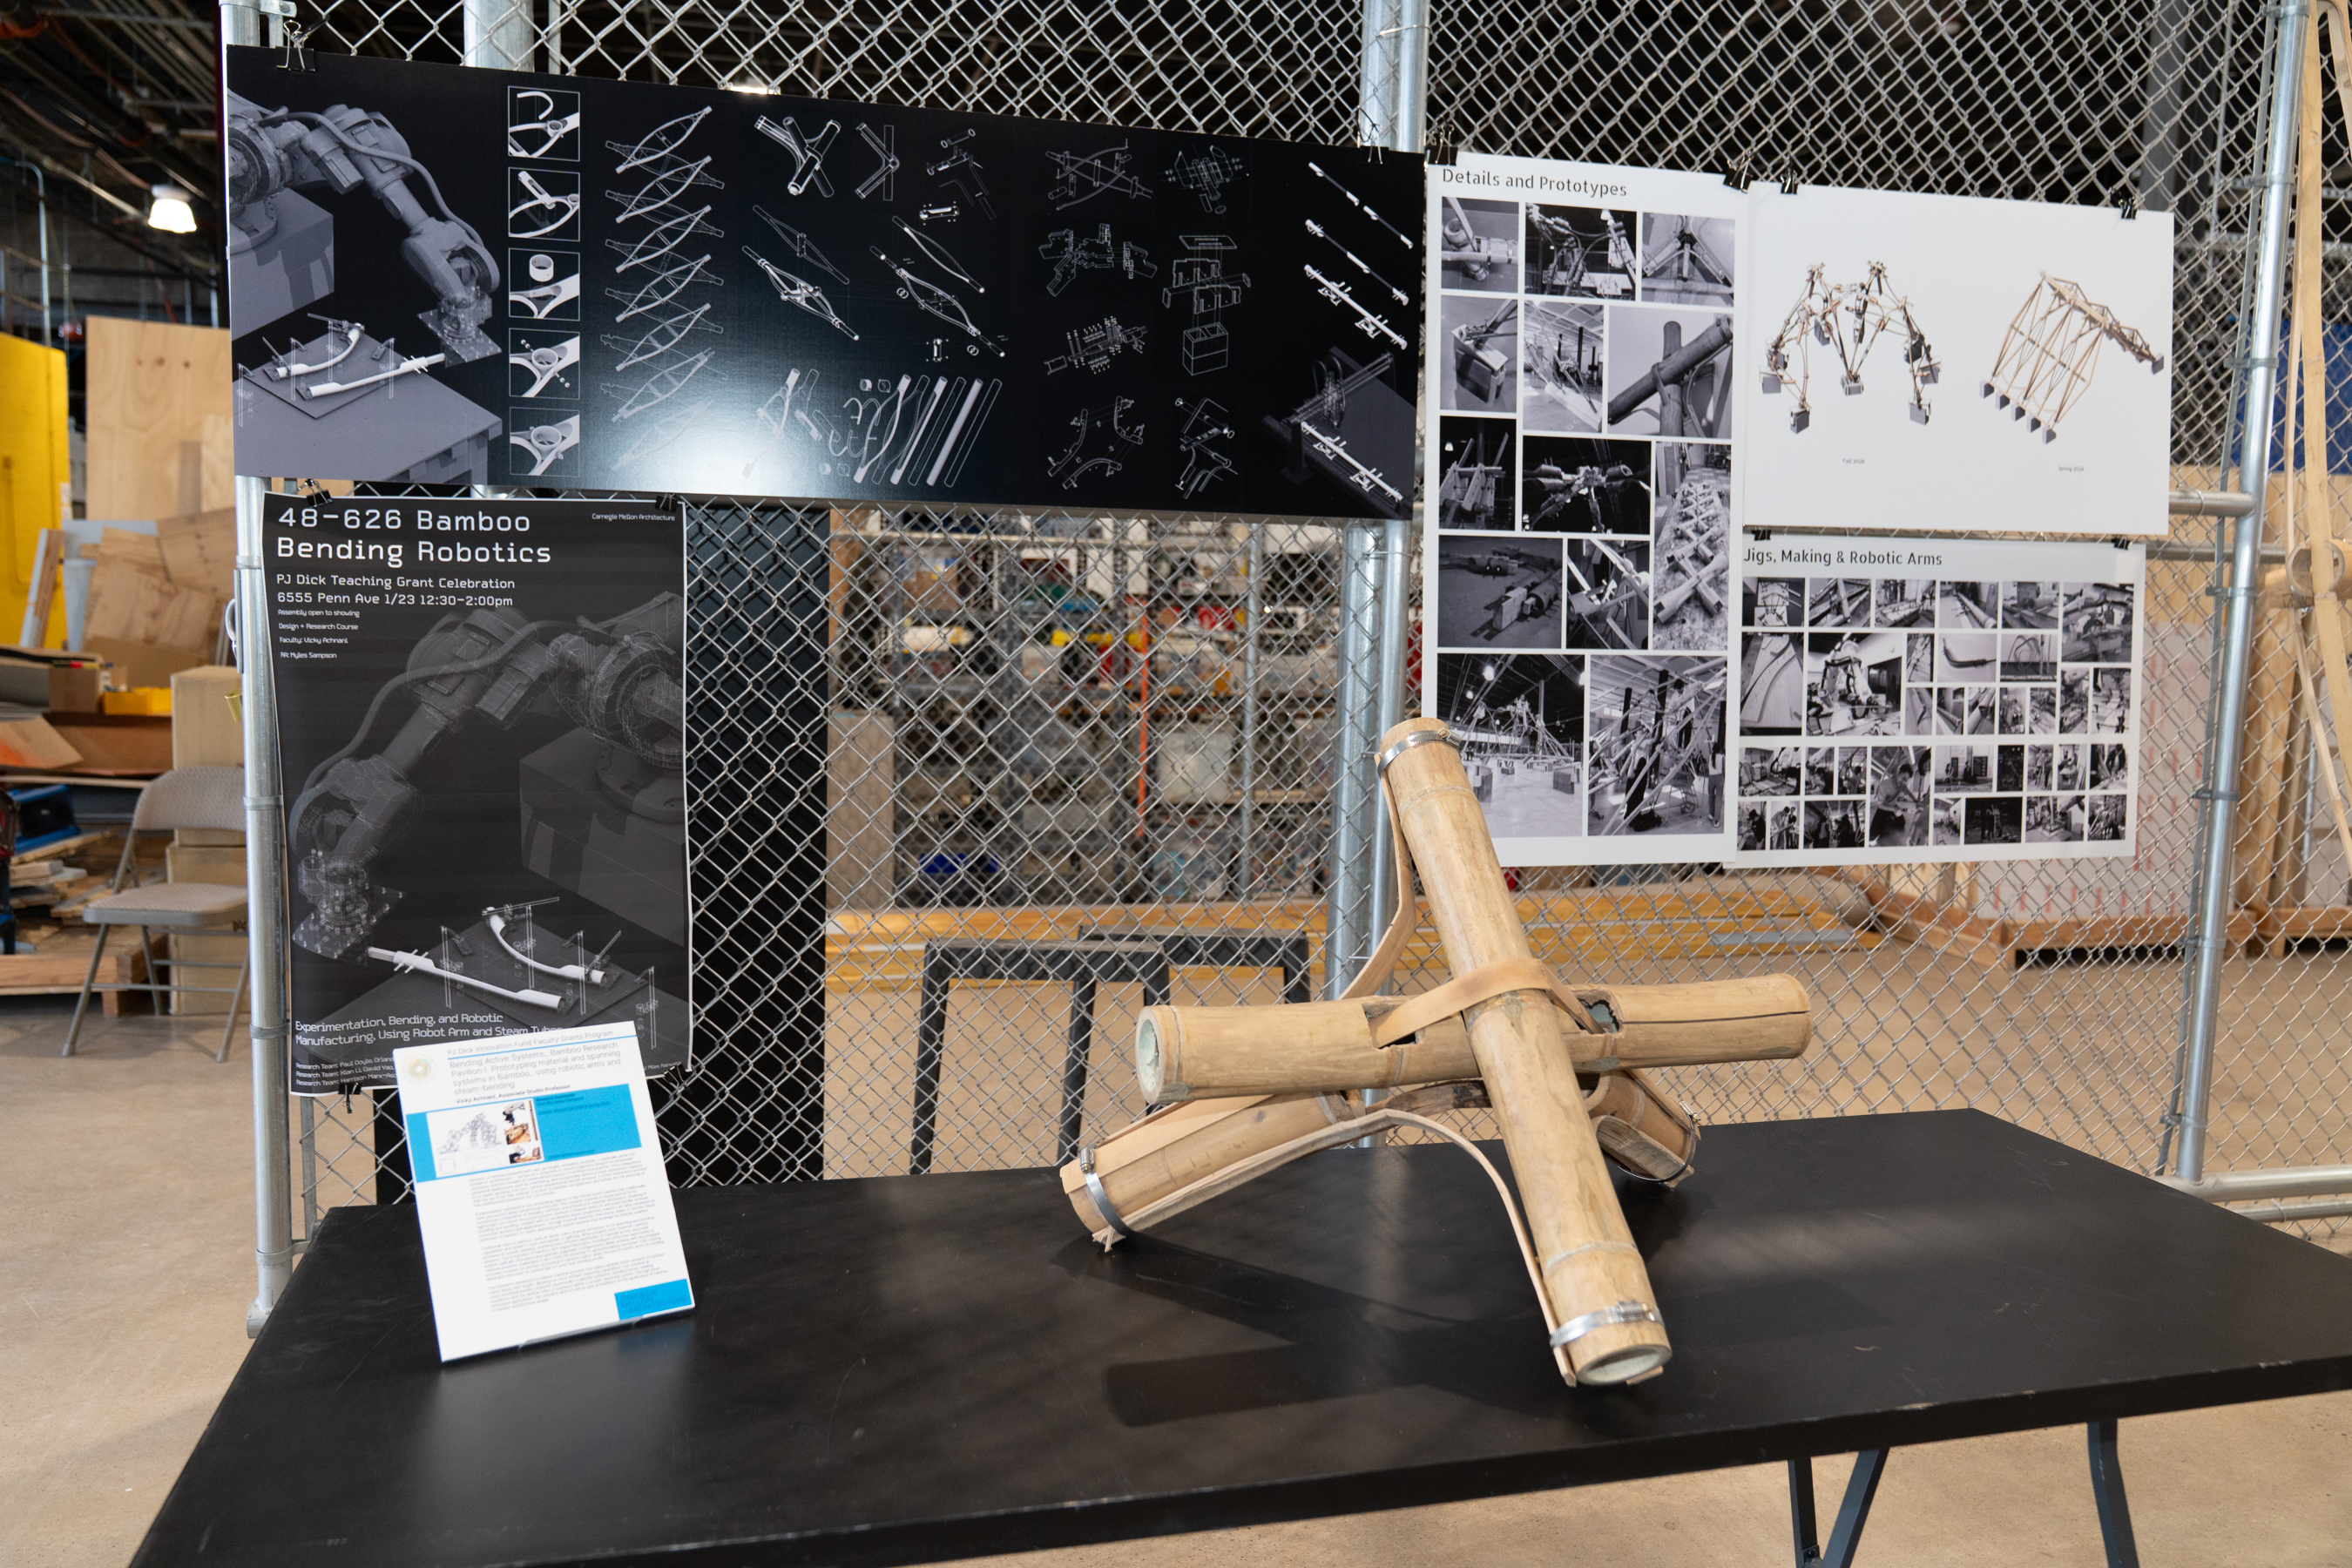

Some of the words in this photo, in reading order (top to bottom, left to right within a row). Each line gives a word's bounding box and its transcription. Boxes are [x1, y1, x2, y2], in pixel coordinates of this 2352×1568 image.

[1443, 168, 1500, 186] Details
[1505, 175, 1534, 188] and
[1540, 176, 1627, 198] Prototypes
[278, 507, 402, 530] 48-626
[417, 510, 531, 531] Bamboo
[277, 537, 403, 568] Bending
[418, 540, 551, 563] Robotics
[1743, 547, 1776, 565] Jigs,
[1781, 549, 1832, 566] Making
[1836, 551, 1845, 564] &
[1850, 551, 1903, 564] Robotic
[1907, 552, 1943, 565] Arms
[277, 574, 291, 585] PJ
[297, 574, 327, 585] Dick
[331, 575, 392, 590] Teaching
[396, 577, 434, 588] Grant
[439, 578, 515, 589] Celebration
[277, 592, 312, 603] 6555
[318, 592, 350, 604] Penn
[355, 593, 380, 604] Ave
[385, 593, 416, 605] 1/23
[420, 594, 513, 608] 12:30-2:00pm
[334, 610, 360, 618] showing
[295, 1018, 386, 1033] Experimentation,
[389, 1015, 436, 1027] Bending,
[438, 1014, 459, 1024] and
[461, 1013, 504, 1023] Robotic
[295, 1033, 376, 1046] Manufacturing,
[378, 1031, 410, 1041] Using
[413, 1028, 445, 1037] Robot
[448, 1027, 470, 1037] Arm
[472, 1026, 493, 1037] and
[495, 1026, 528, 1036] Steam
[449, 1059, 483, 1068] Bending
[550, 1047, 582, 1056] Bamboo
[583, 1042, 618, 1051] Research
[490, 1062, 537, 1071] Prototyping
[538, 1057, 569, 1065] material
[587, 1051, 620, 1060] spanning
[341, 1075, 368, 1084] Harrison
[453, 1077, 486, 1087] systems
[455, 1082, 515, 1095] steam-bending
